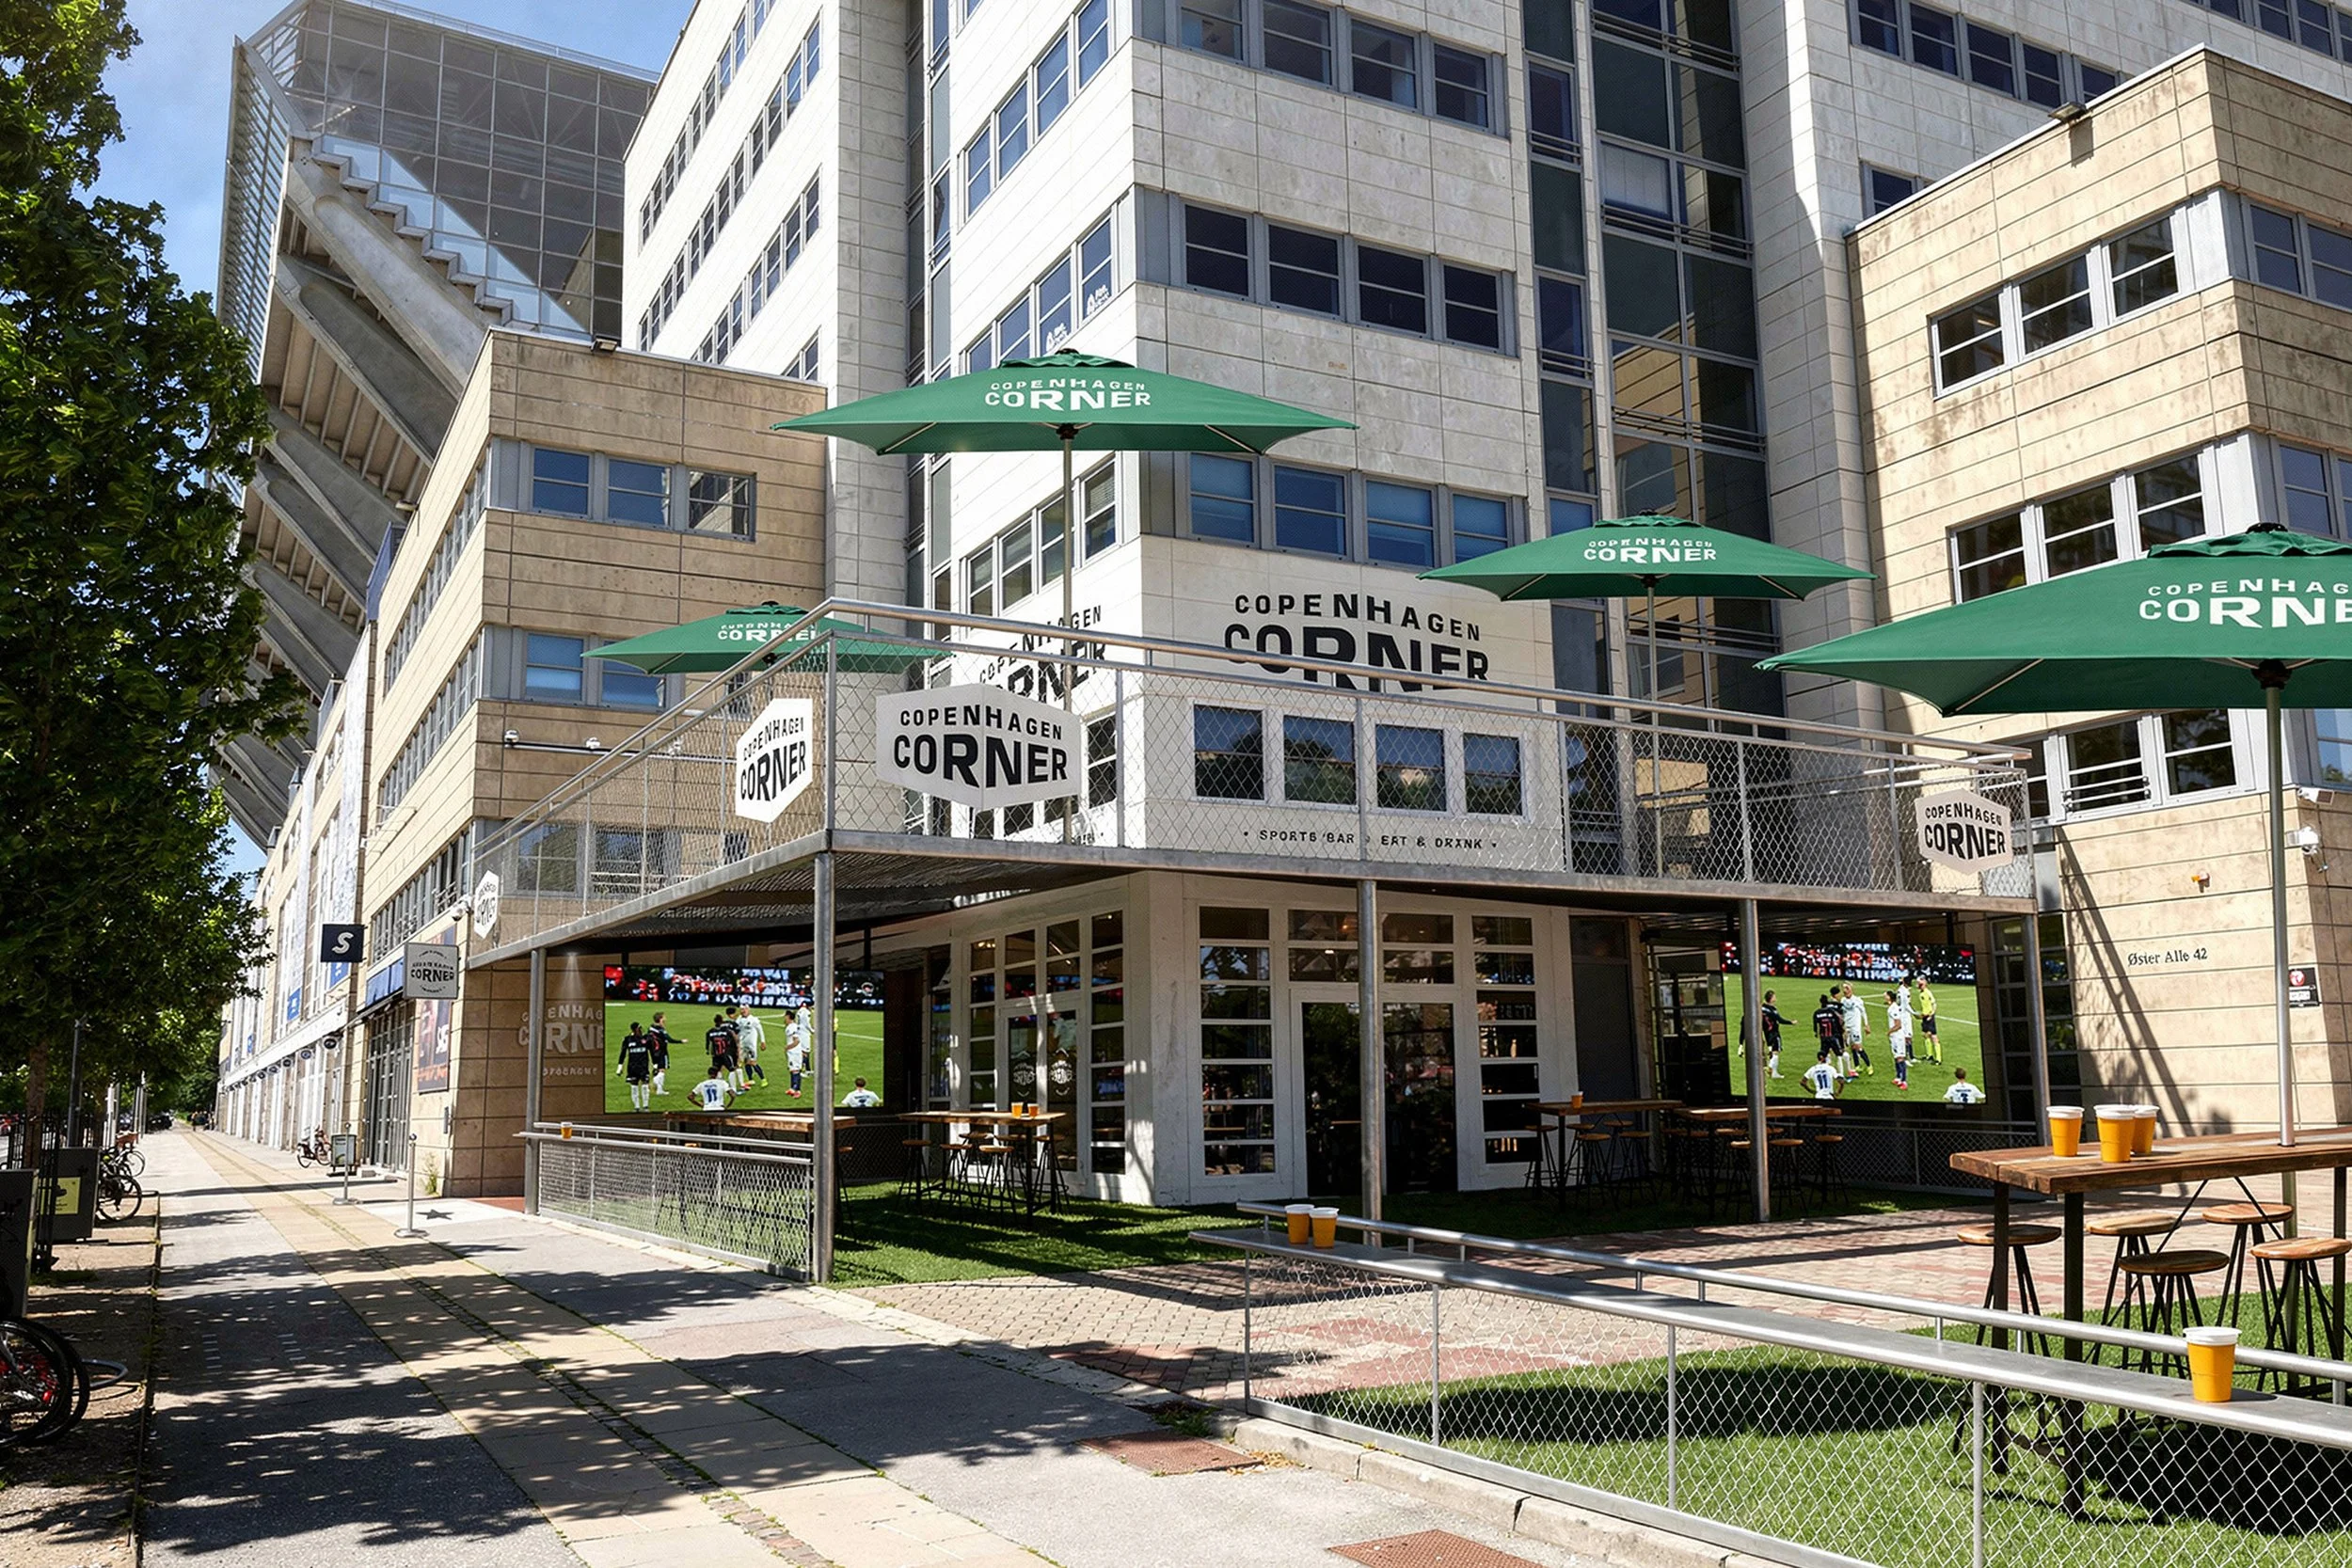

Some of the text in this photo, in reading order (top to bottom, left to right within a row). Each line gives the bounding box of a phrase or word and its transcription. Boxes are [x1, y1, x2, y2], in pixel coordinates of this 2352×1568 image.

[991, 378, 1145, 390] COPENHAGEN
[985, 390, 1151, 411] CORNER
[1588, 537, 1712, 548] COPENHAGEN
[1583, 547, 1717, 564] CORNER
[2148, 578, 2349, 596] COPENHAG
[1235, 594, 1481, 641] COPENHAGEN
[1225, 624, 1489, 693] CORNER
[900, 705, 1062, 740] COPENHAGEN
[740, 740, 806, 801] CORNER
[894, 734, 1068, 788] CORNER
[1925, 801, 2003, 826] COPENHAGEN
[1260, 830, 1482, 848] SPORTS BAR EAT & DRINK
[1925, 822, 2006, 860] CORNER
[331, 931, 354, 954] S
[2127, 952, 2161, 967] Øster
[2193, 947, 2208, 960] 42
[411, 968, 454, 983] CORNER
[521, 1004, 603, 1022] CENHAG
[518, 1022, 603, 1053] CRN
